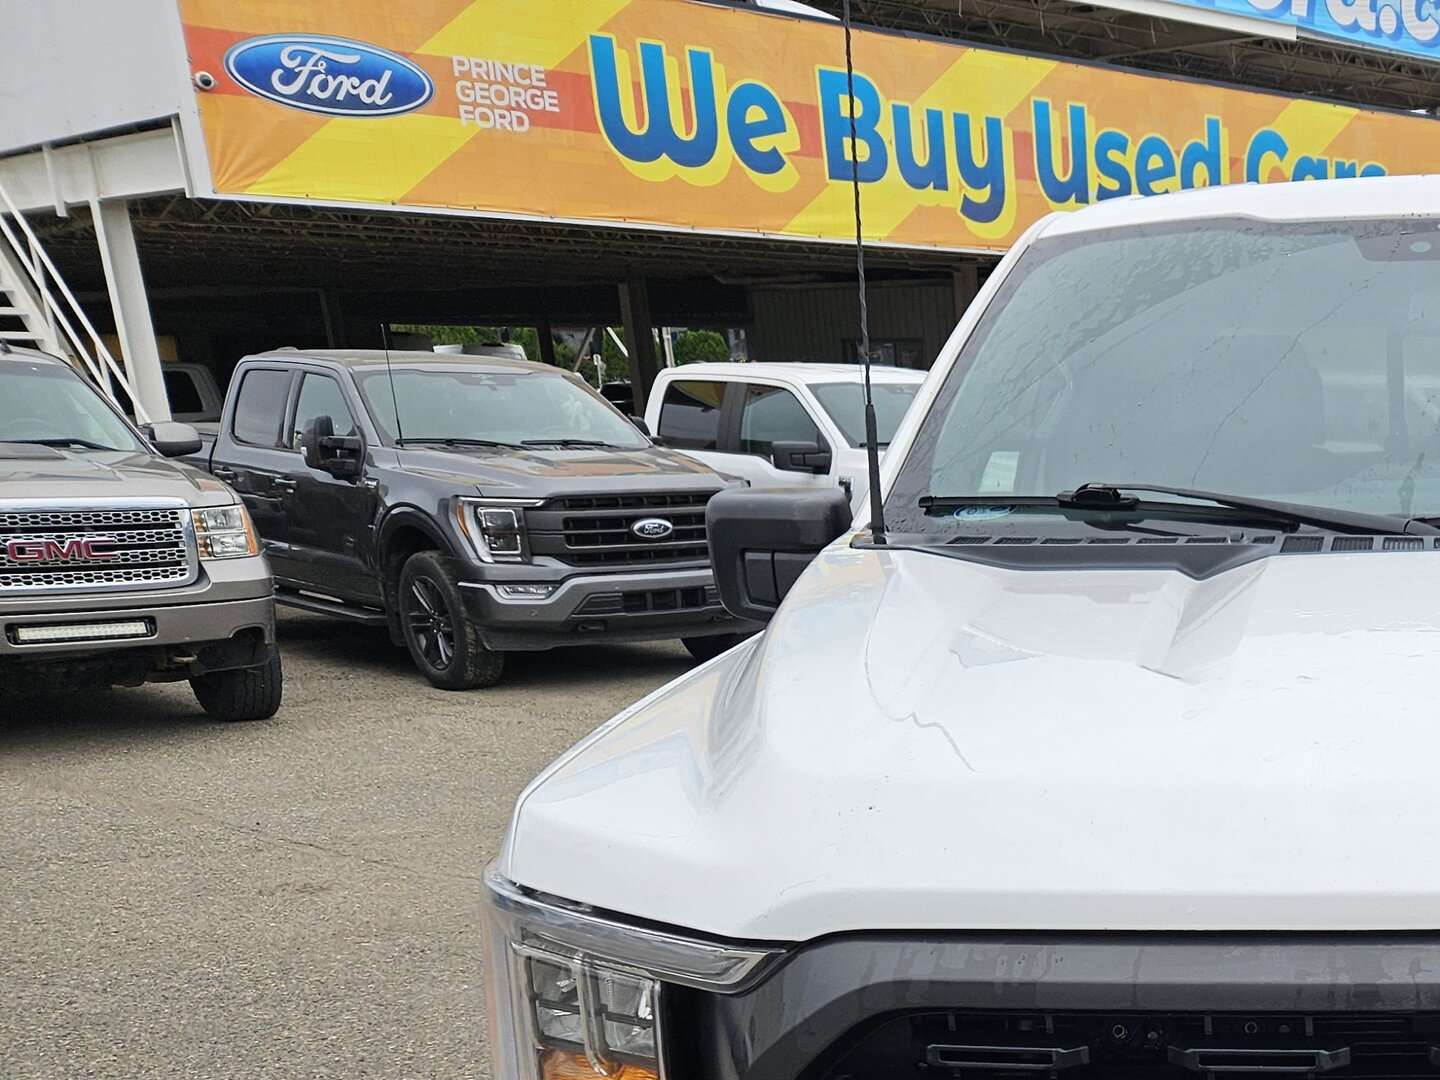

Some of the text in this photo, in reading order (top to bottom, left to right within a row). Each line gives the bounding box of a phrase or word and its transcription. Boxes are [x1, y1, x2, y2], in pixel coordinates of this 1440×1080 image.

[271, 45, 393, 105] Ford
[452, 56, 547, 87] PRINCE
[456, 80, 560, 112] GEORGE
[459, 104, 529, 132] FORD
[588, 32, 788, 177] We
[817, 67, 1007, 224] Buy
[1032, 98, 1222, 204] Used
[7, 537, 120, 561] GMC
